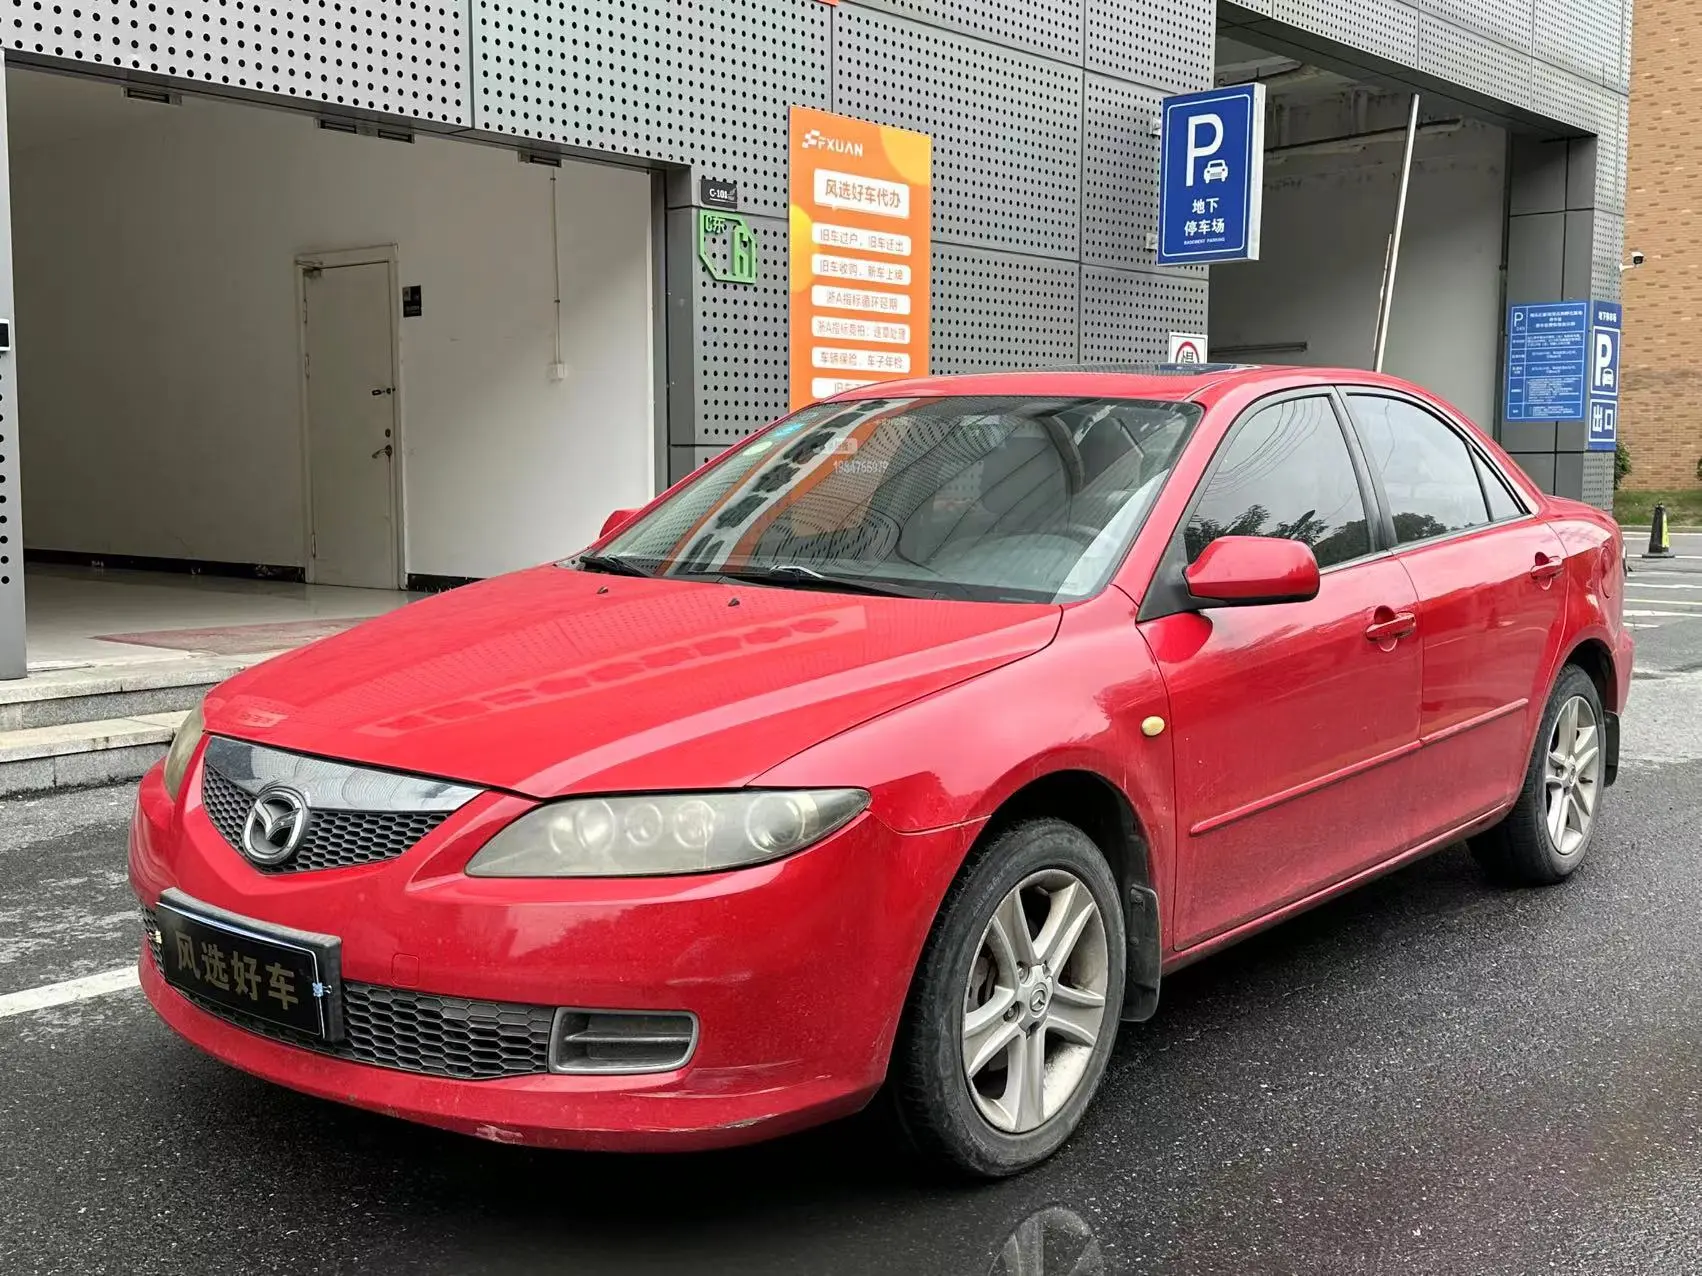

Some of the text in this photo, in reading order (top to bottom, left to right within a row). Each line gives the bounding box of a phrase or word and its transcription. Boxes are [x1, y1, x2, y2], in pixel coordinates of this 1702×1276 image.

[818, 137, 863, 157] FXUAN
[1186, 113, 1224, 186] P
[825, 179, 901, 208] 风选好车代办
[1192, 198, 1220, 214] 地下
[1184, 218, 1225, 236] 停车场
[1595, 333, 1612, 386] P
[1592, 404, 1614, 433] 出口
[175, 930, 299, 1011] 风选好车
